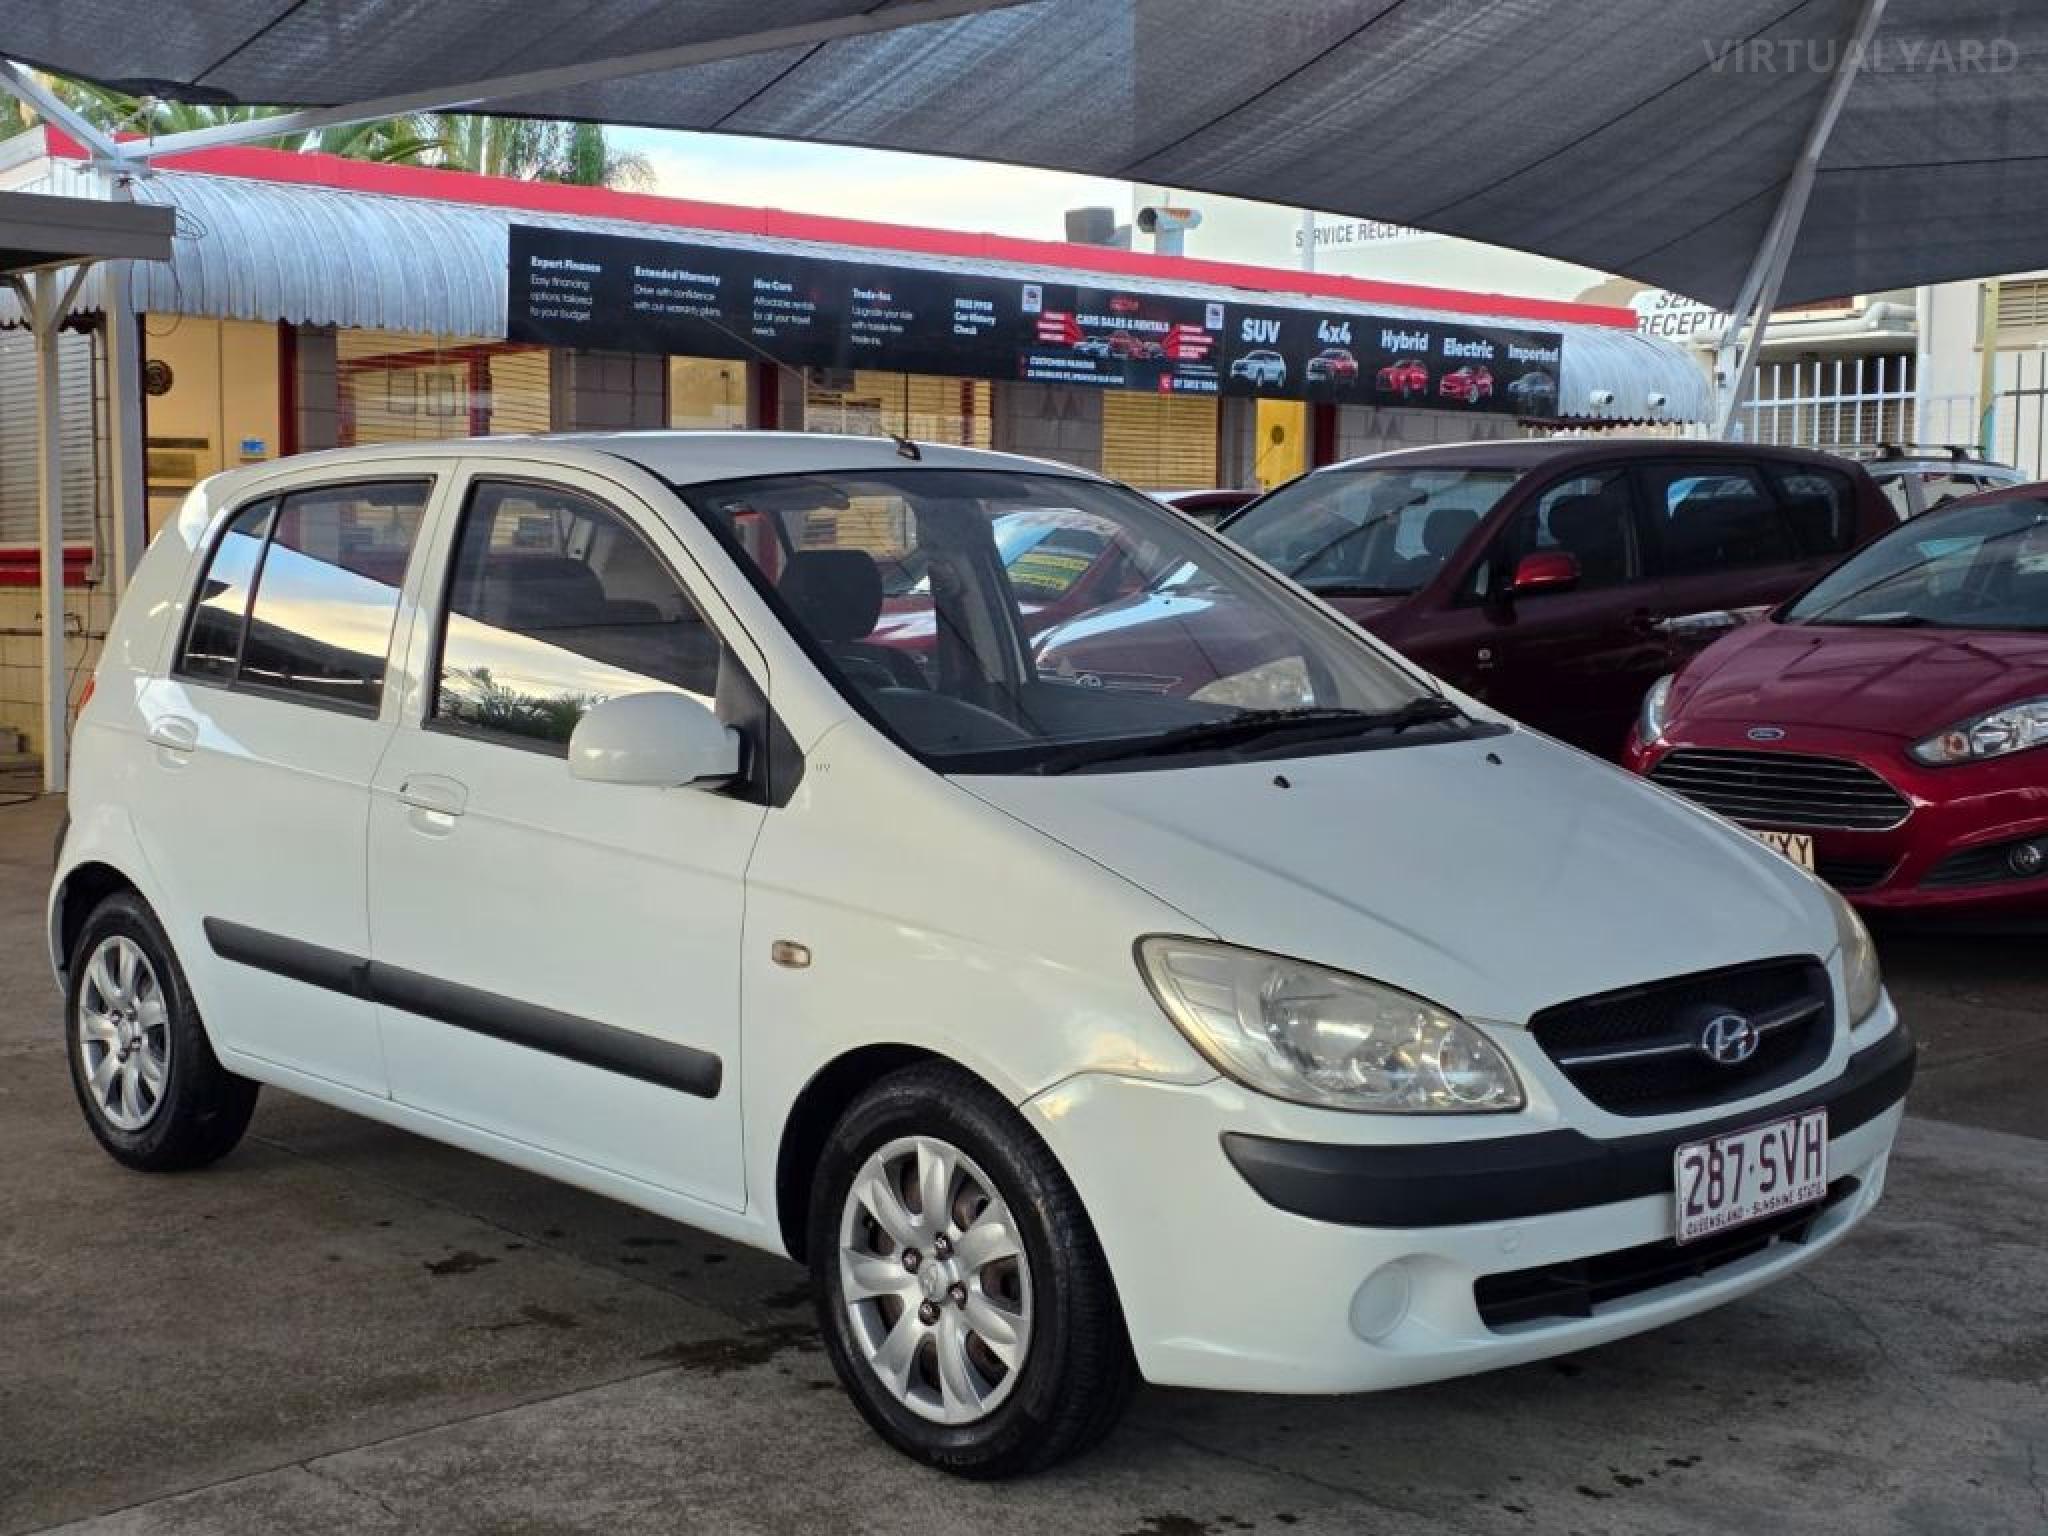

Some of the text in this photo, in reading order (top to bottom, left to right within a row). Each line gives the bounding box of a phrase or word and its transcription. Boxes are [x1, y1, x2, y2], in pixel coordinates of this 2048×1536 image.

[1296, 224, 1353, 248] SRVICE
[1241, 319, 1281, 343] SUV
[1317, 319, 1352, 344] 4x4
[1381, 329, 1429, 352] Hybrid
[1443, 337, 1494, 359] Electric
[1508, 343, 1559, 362] Imported
